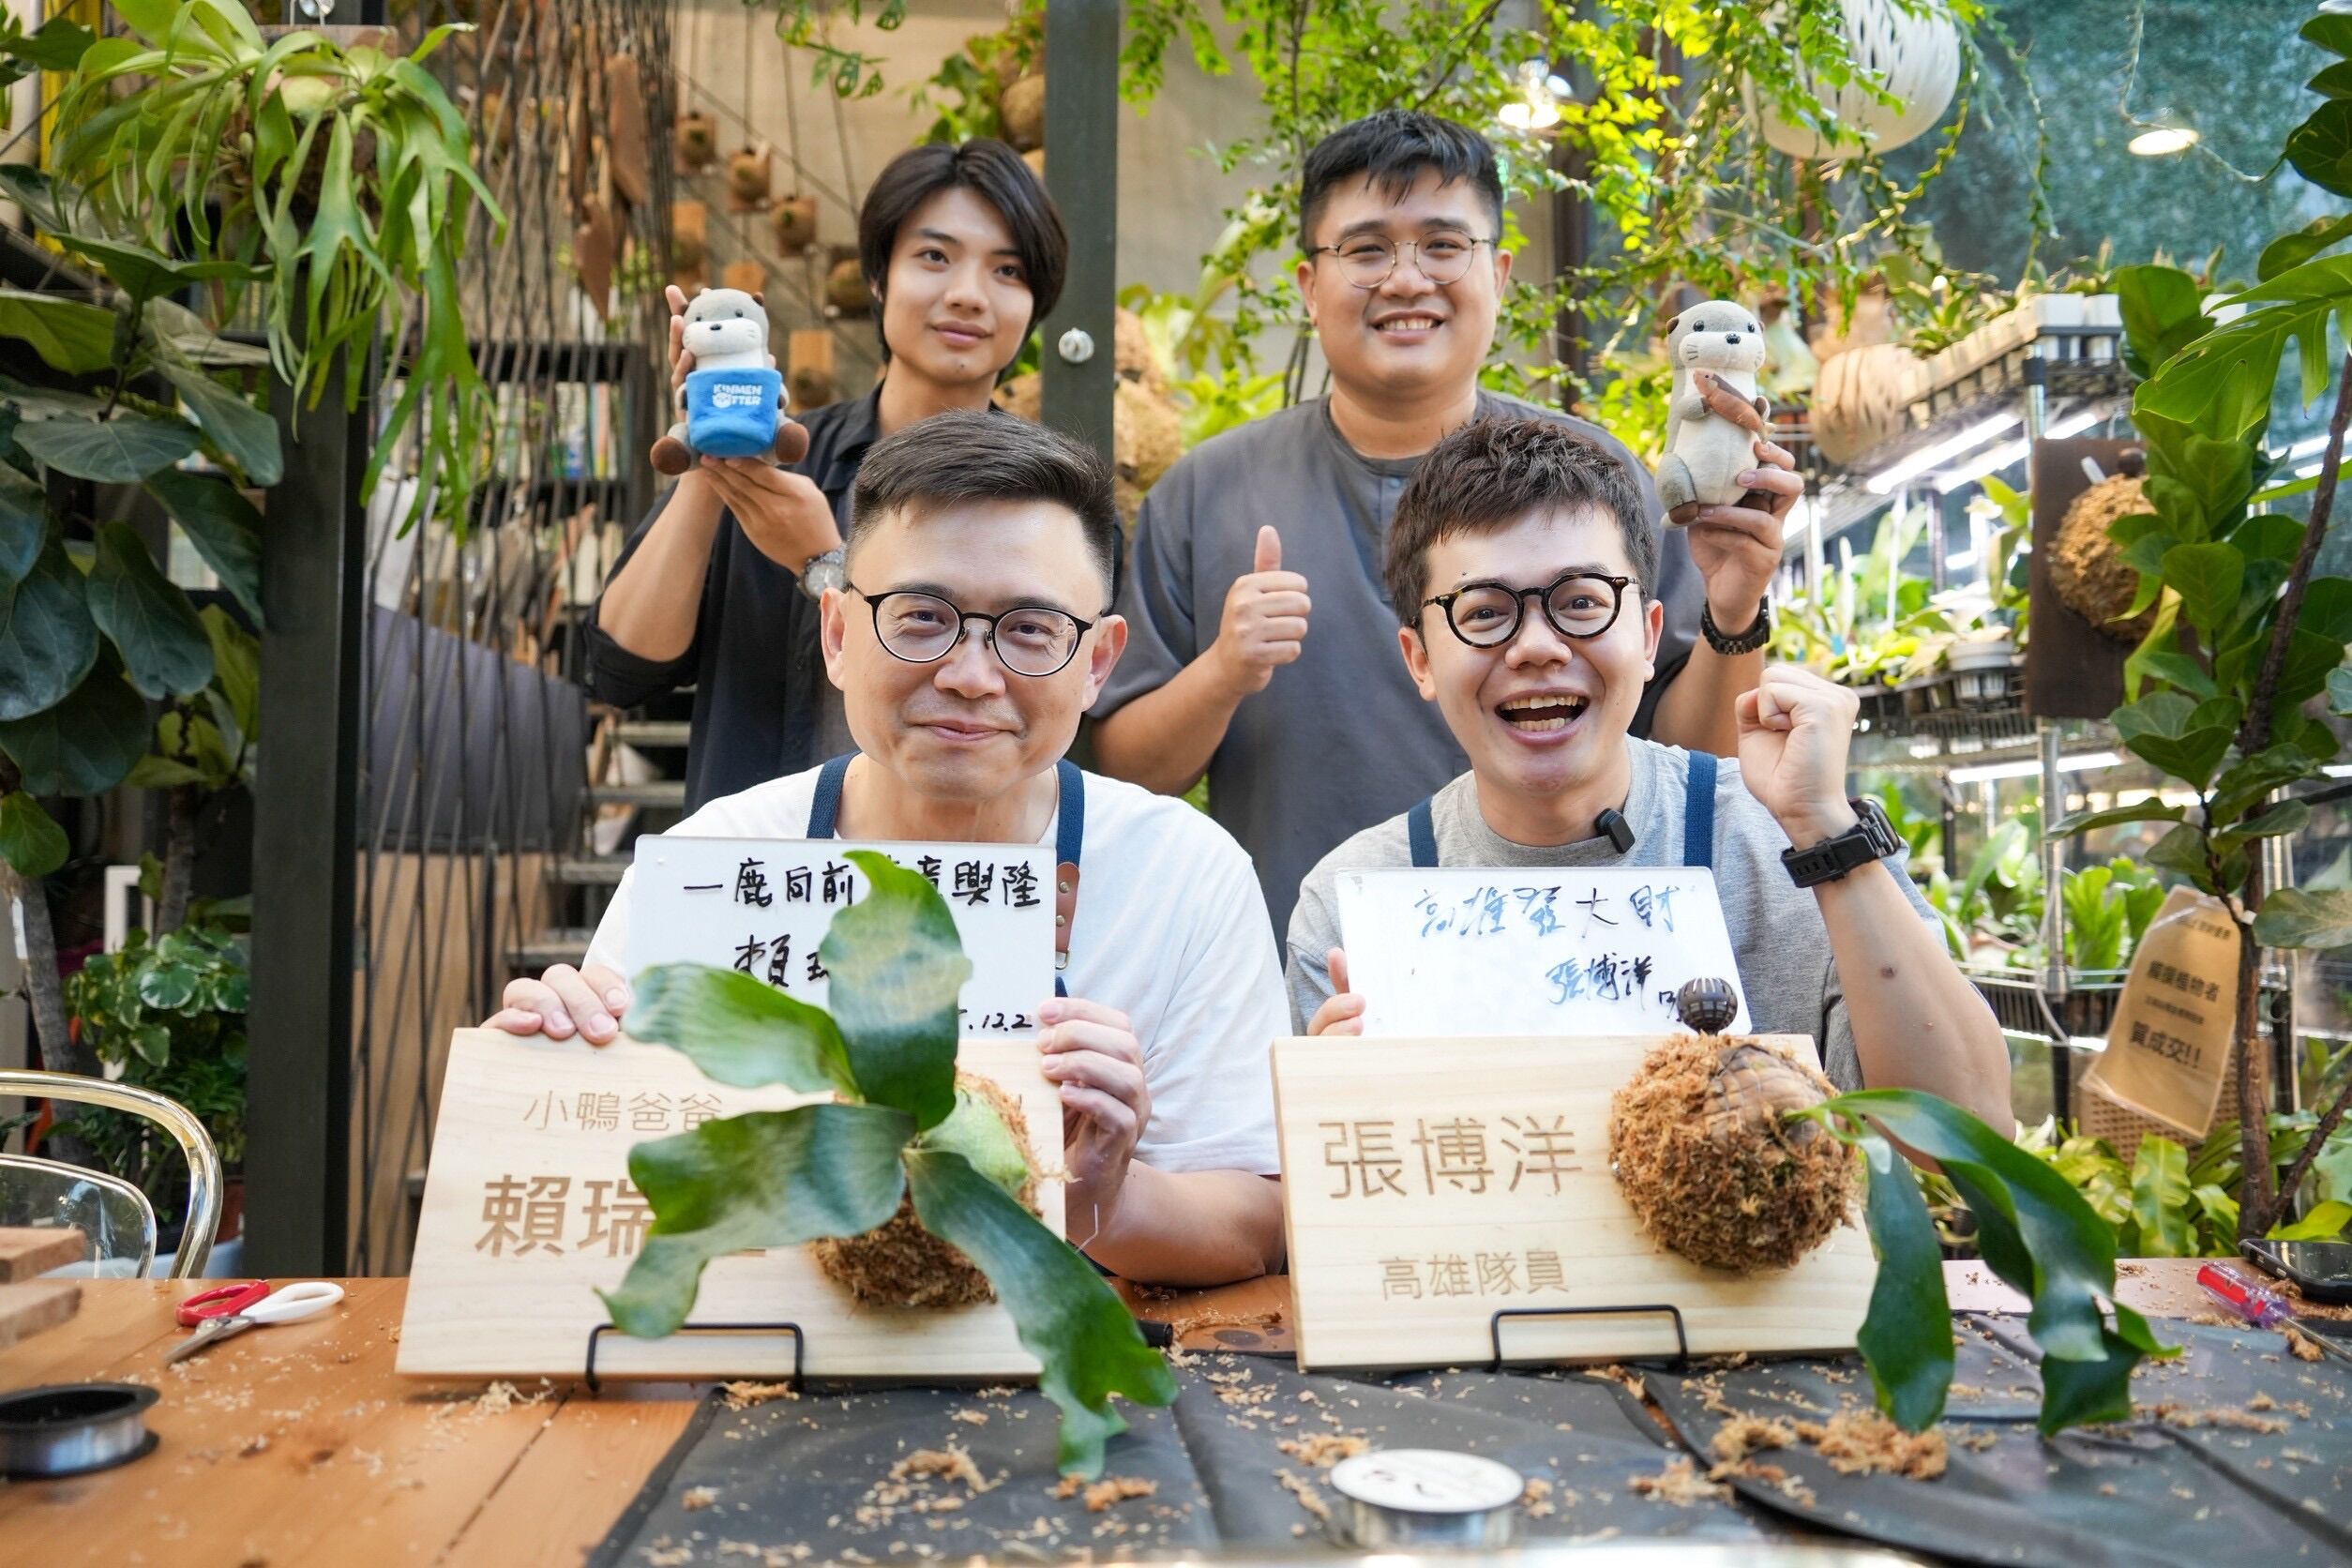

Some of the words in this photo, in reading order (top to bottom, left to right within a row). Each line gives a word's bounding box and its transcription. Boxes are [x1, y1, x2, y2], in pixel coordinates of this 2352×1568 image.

[713, 384, 762, 395] KINMEN
[1545, 953, 1652, 1011] 張博洋
[523, 1090, 723, 1132] 小鴨爸爸
[1317, 1114, 1583, 1199] 張博洋
[1379, 1249, 1570, 1302] 高雄隊員
